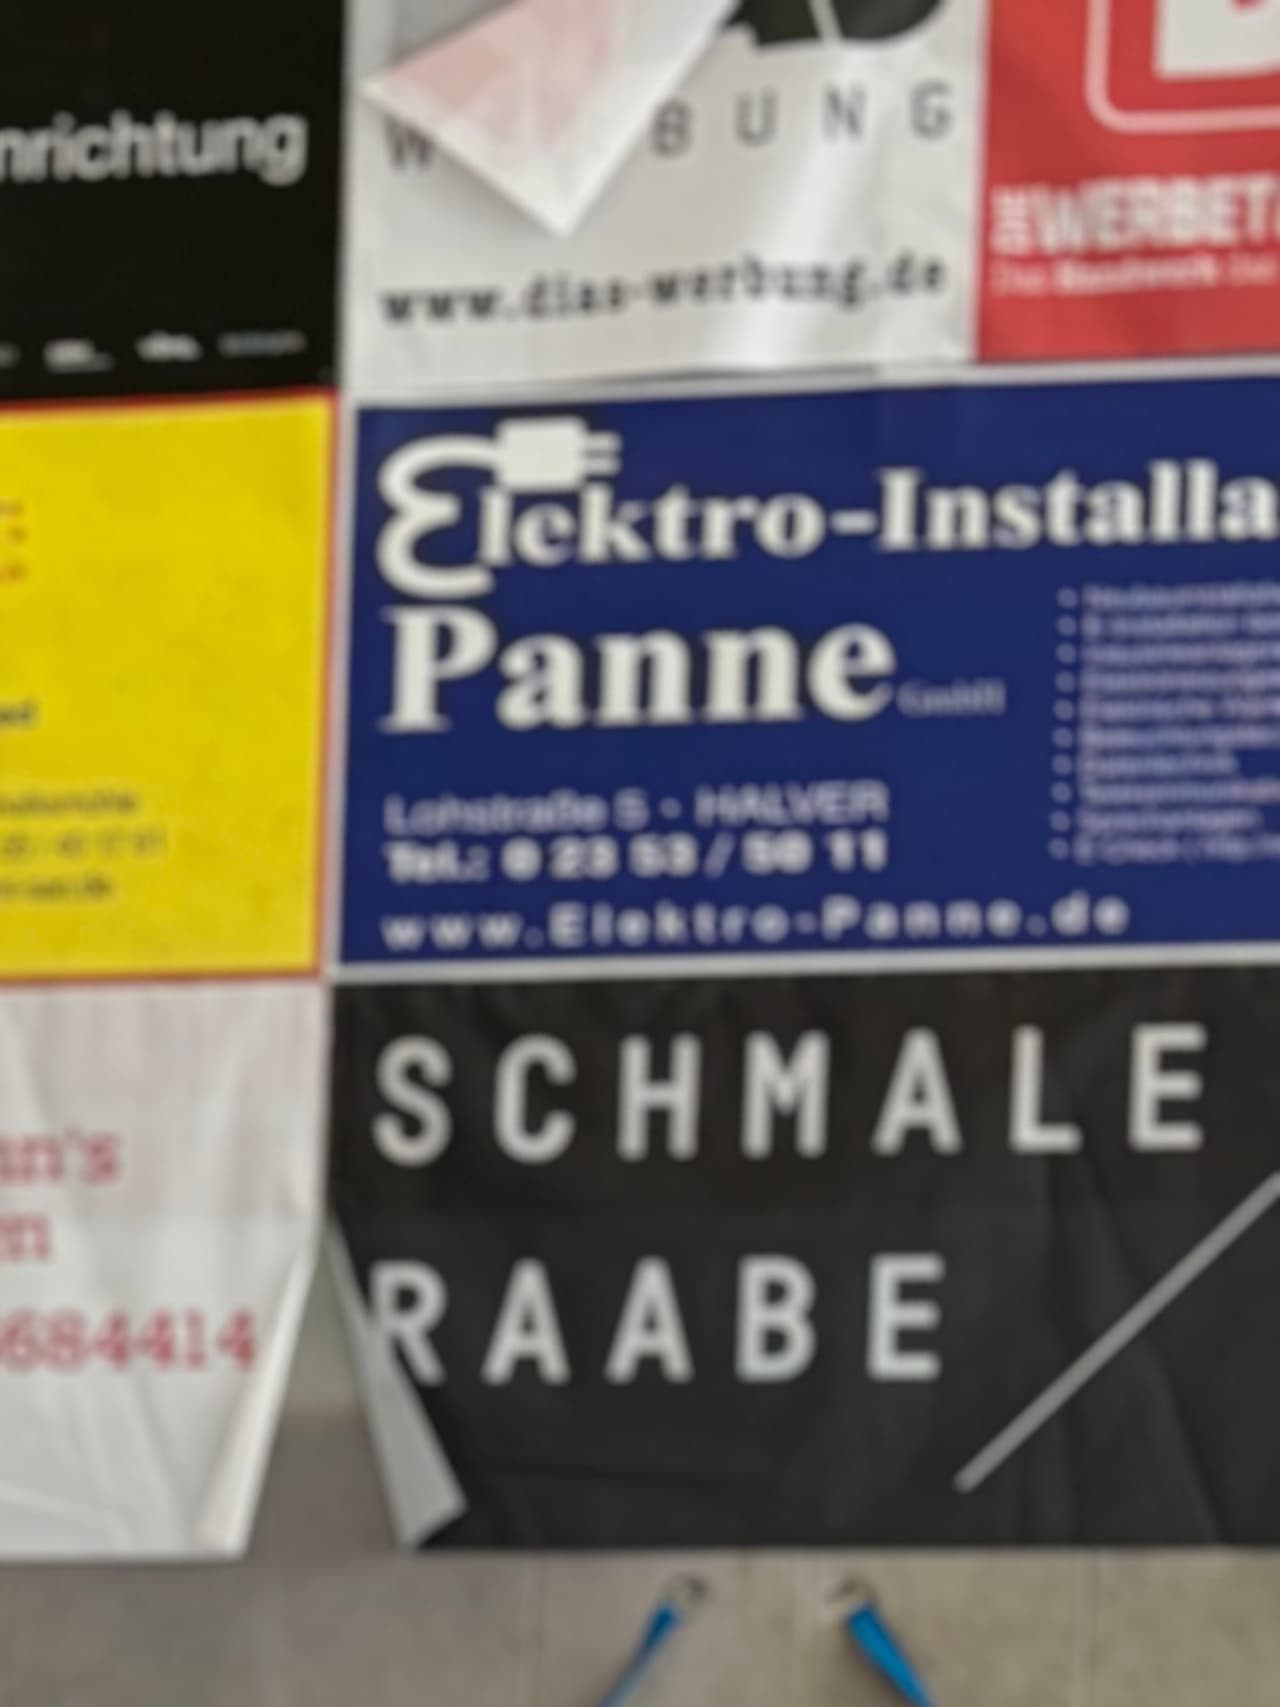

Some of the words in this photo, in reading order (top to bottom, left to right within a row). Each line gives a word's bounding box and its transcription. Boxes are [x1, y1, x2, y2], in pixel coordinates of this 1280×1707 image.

[380, 602, 897, 733] Panne
[692, 780, 890, 828] HALVER
[380, 889, 1131, 949] www.Elektro-Panne.de
[372, 1021, 1208, 1168] SCHMALE
[368, 1251, 946, 1387] RAABE
